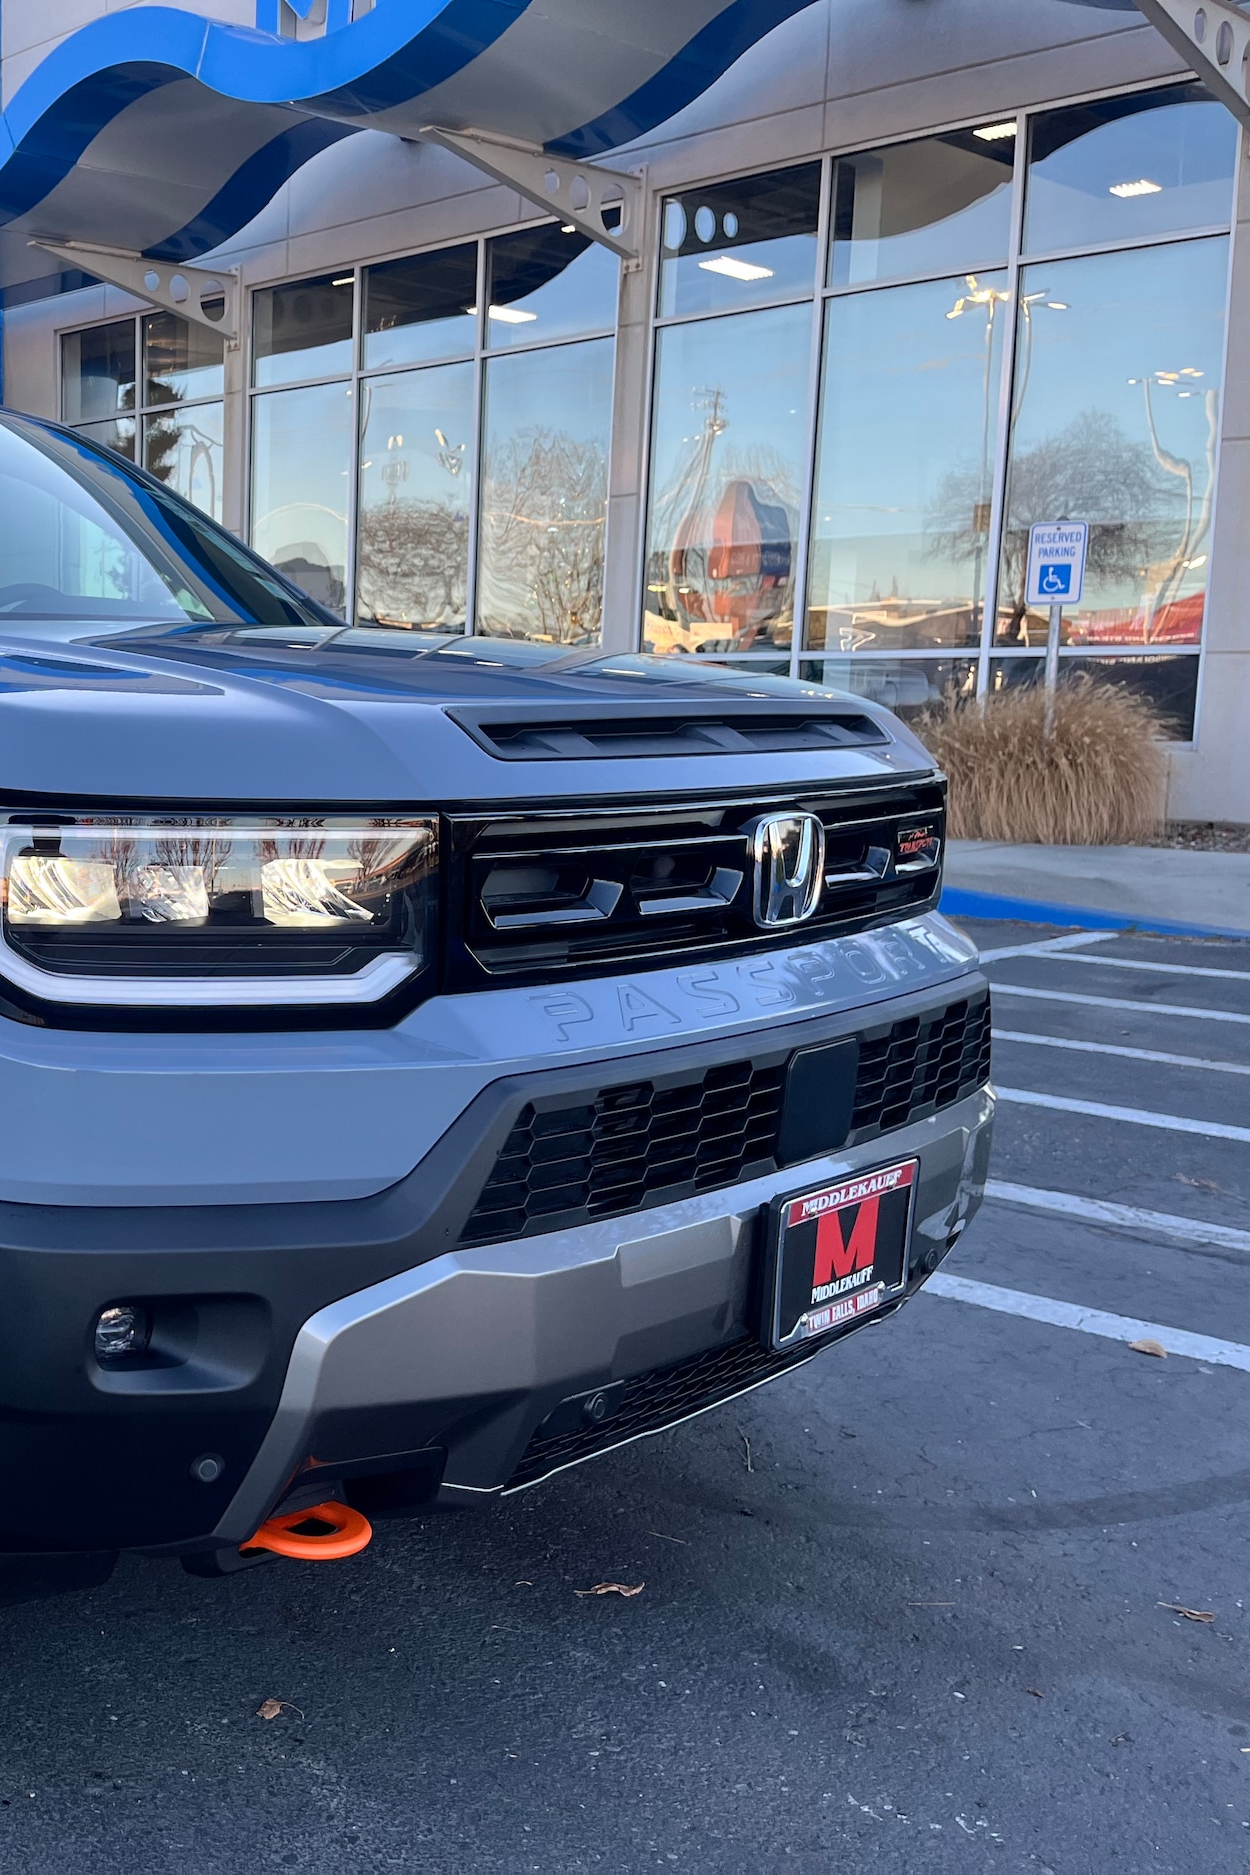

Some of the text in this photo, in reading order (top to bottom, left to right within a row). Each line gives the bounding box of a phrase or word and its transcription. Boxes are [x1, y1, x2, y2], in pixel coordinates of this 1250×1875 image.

[1034, 531, 1082, 544] RESERVED
[1038, 546, 1076, 558] PARKING
[526, 924, 948, 1042] PASSPORT
[801, 1169, 902, 1217] MIDDLEKAUFF
[813, 1195, 880, 1287] M
[811, 1265, 874, 1305] MIDDLEKAUFF
[809, 1289, 879, 1331] TWIN FALLS, IDAHO
